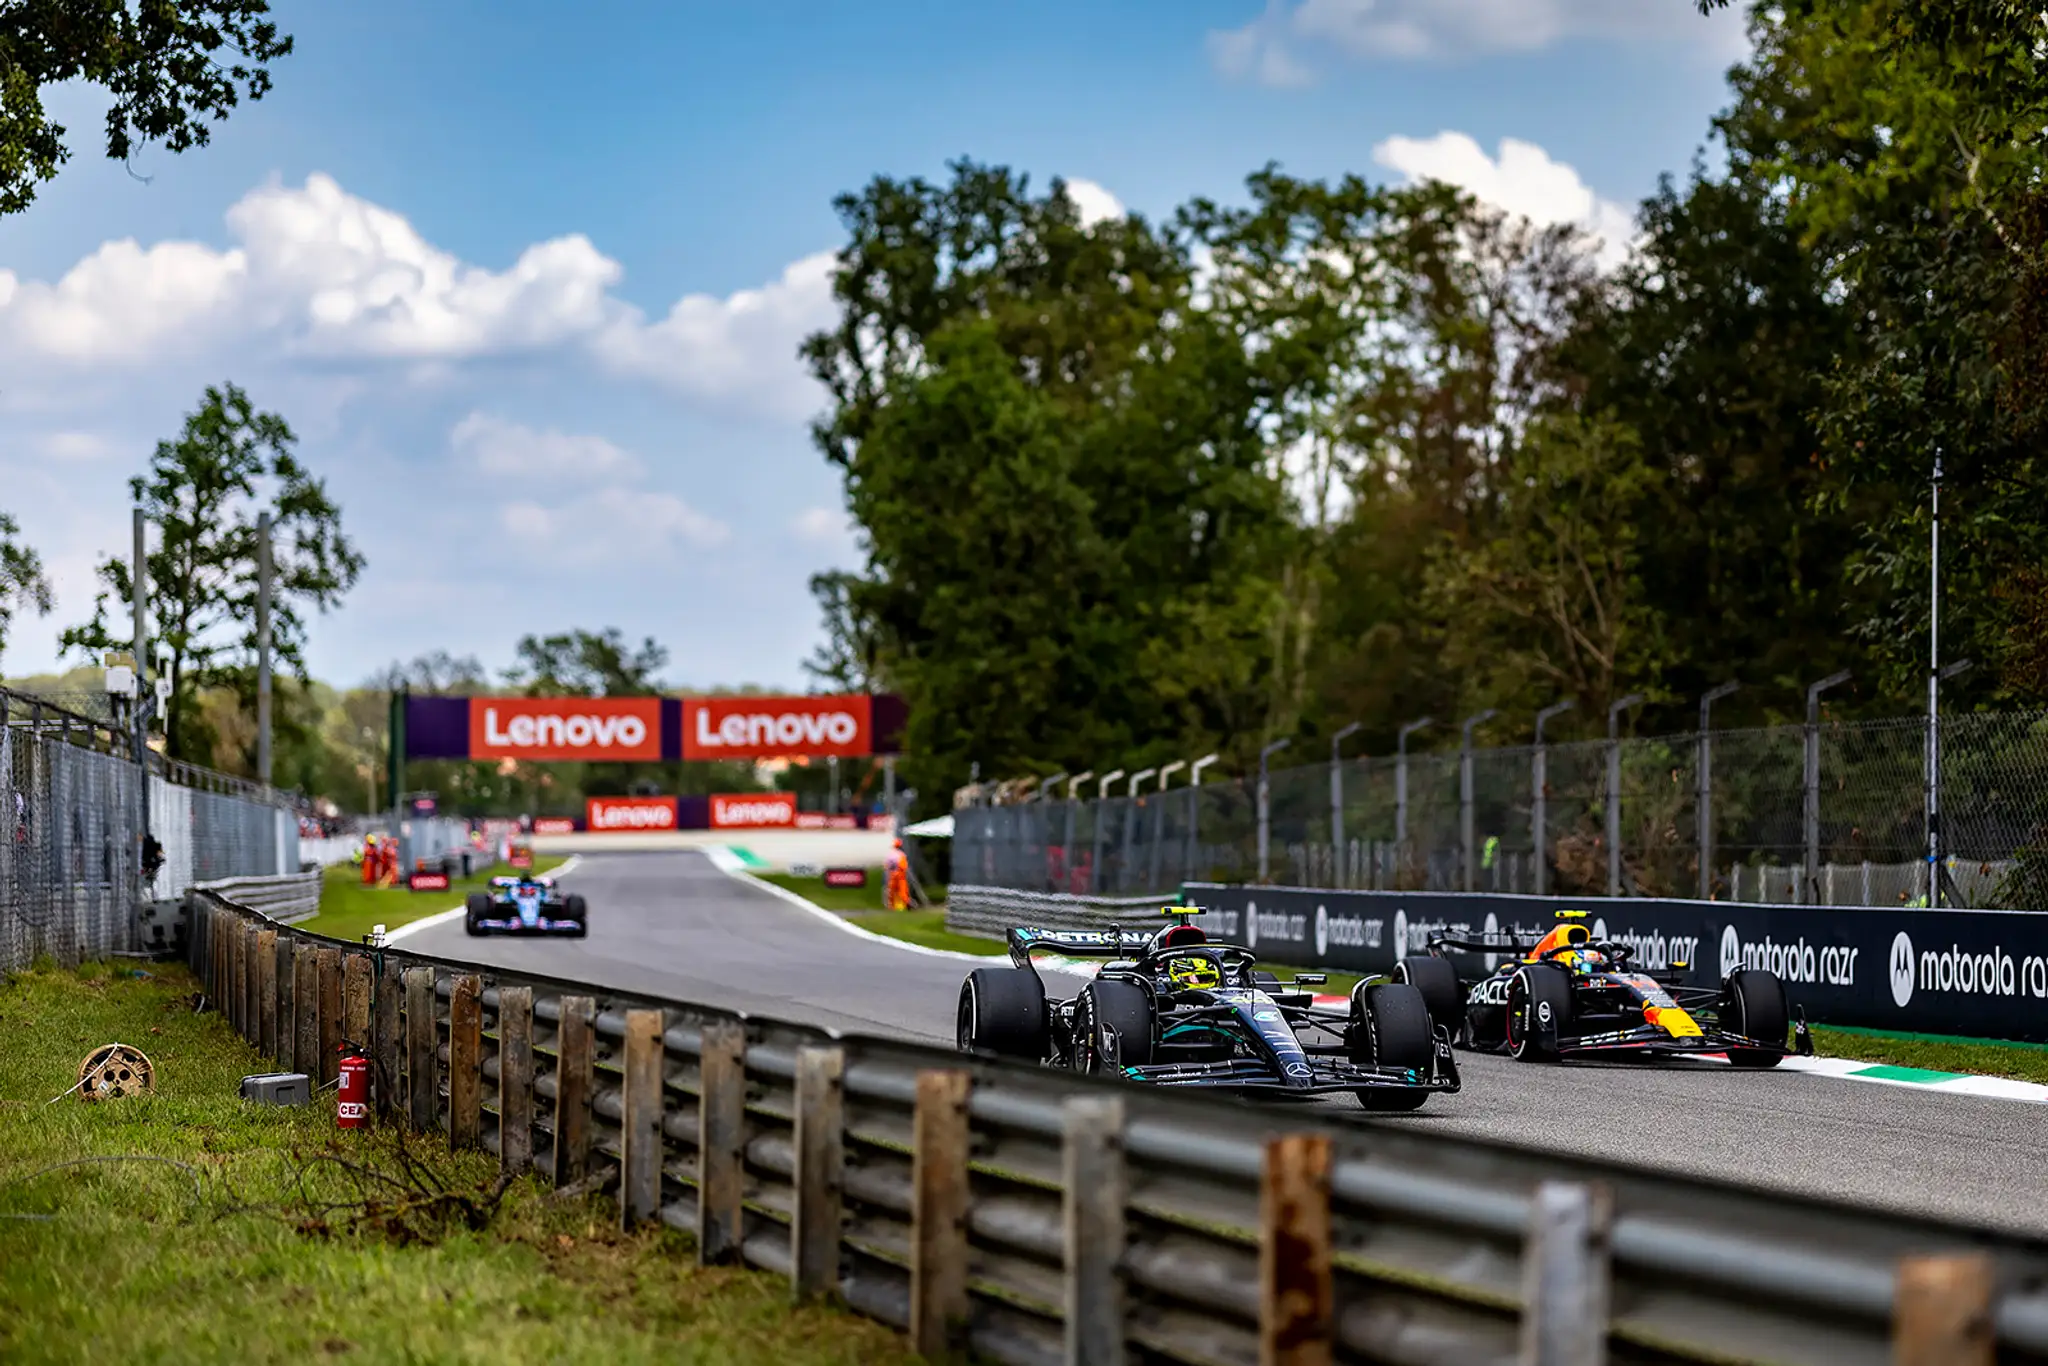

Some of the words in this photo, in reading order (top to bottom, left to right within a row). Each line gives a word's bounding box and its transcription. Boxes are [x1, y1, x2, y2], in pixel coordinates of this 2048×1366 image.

[484, 708, 647, 748] Lenovo
[696, 707, 858, 746] Lenovo
[592, 802, 673, 829] Lenovo
[714, 799, 793, 825] Lenovo
[1041, 930, 1152, 943] PETRONA
[1742, 935, 1816, 983] motorola
[1820, 945, 1859, 986] razr
[1920, 943, 2015, 996] motorola
[2022, 955, 2048, 998] ra
